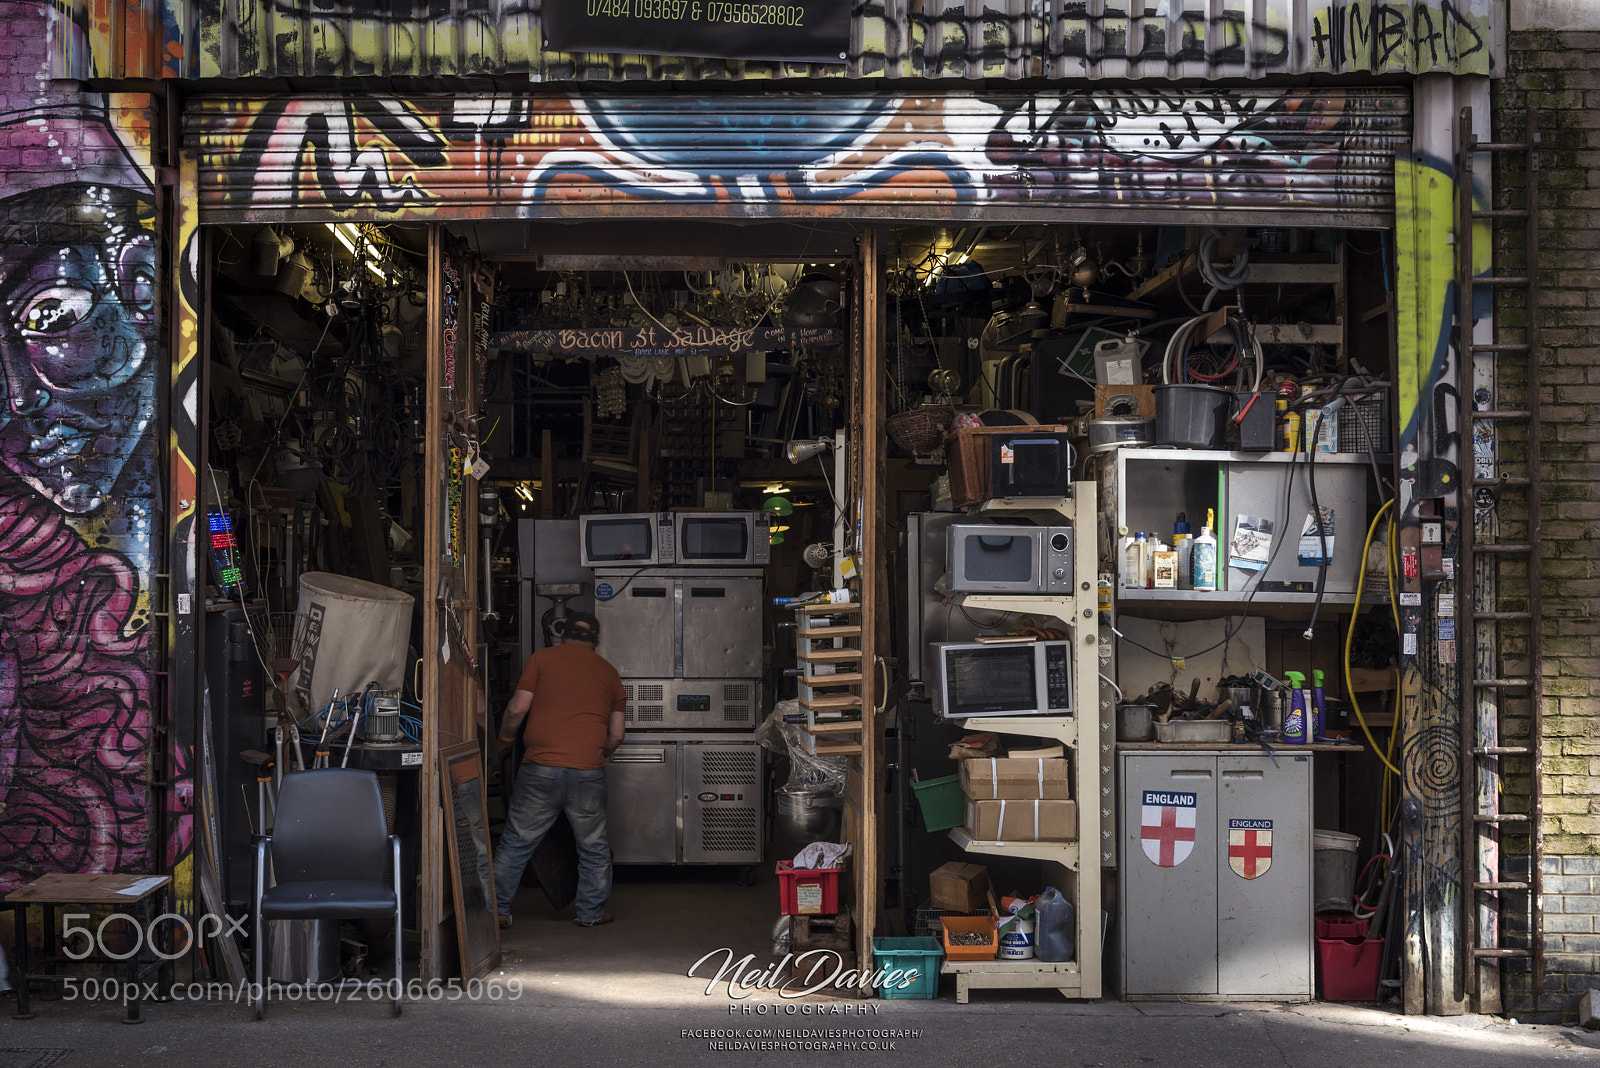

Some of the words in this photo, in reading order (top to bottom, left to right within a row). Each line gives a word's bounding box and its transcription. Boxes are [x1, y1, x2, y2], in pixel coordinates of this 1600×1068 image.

[587, 0, 630, 18] 07484
[634, 0, 687, 20] 093697
[691, 9, 703, 21] &
[707, 2, 804, 27] 07956528802
[558, 328, 624, 350] Bacon
[630, 327, 657, 349] St
[1145, 793, 1194, 806] ENGLAND
[1231, 819, 1271, 828] ENGLAND
